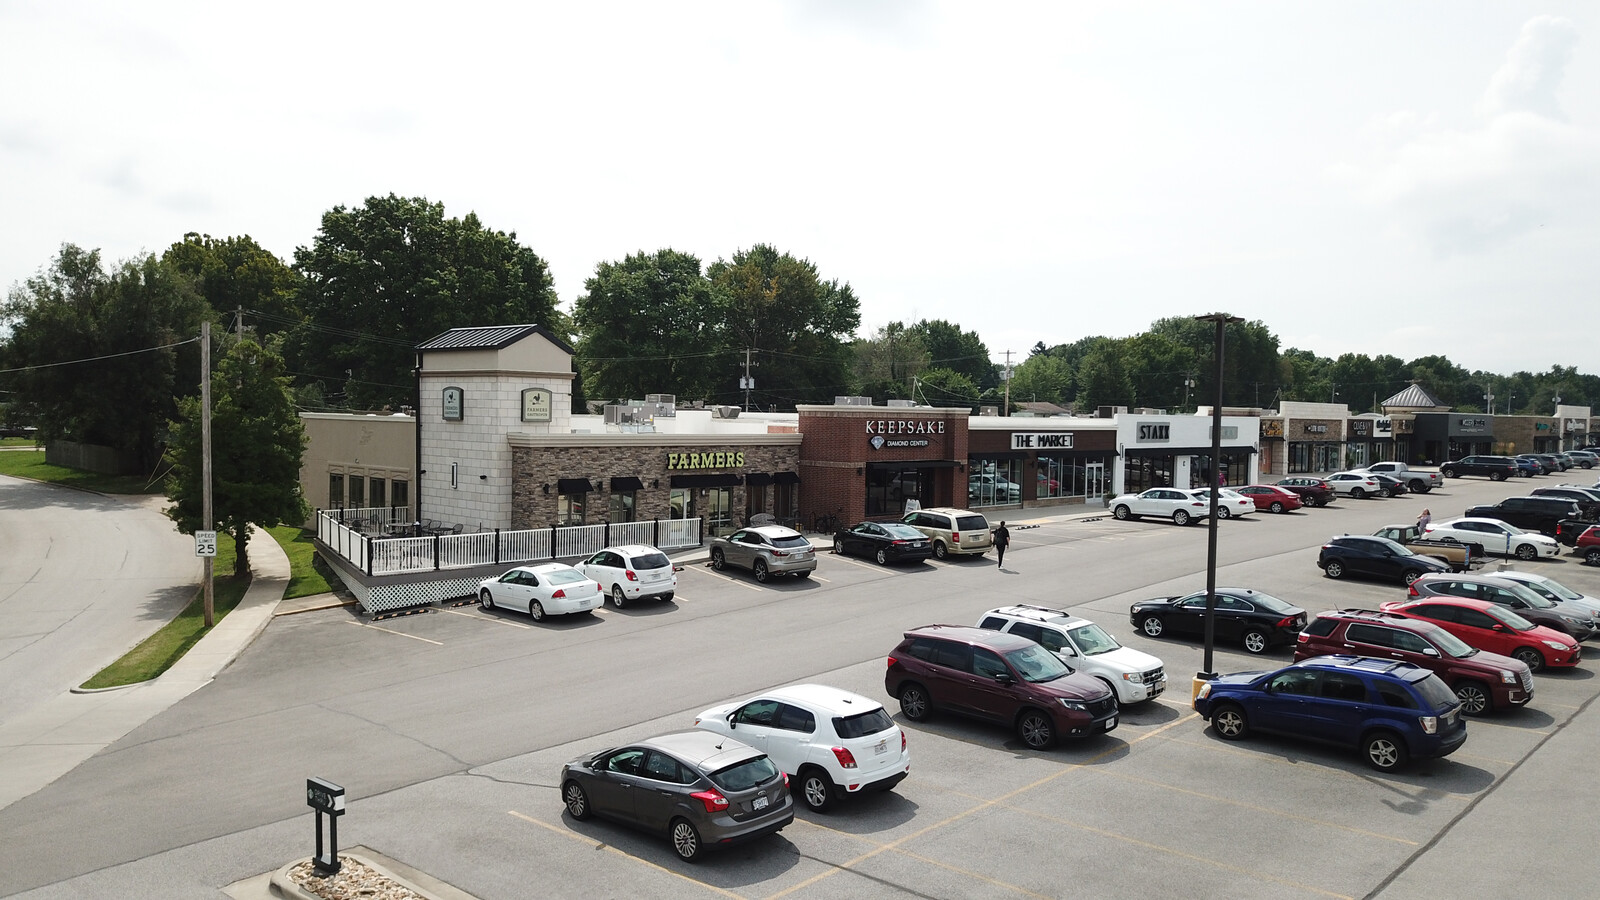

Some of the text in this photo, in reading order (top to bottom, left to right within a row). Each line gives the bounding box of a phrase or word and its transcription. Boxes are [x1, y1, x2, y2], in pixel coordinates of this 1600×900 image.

[866, 421, 945, 434] KEEPSAKE
[1014, 434, 1074, 448] THE MARKET
[667, 452, 745, 470] FARMERS
[197, 544, 215, 554] 25
